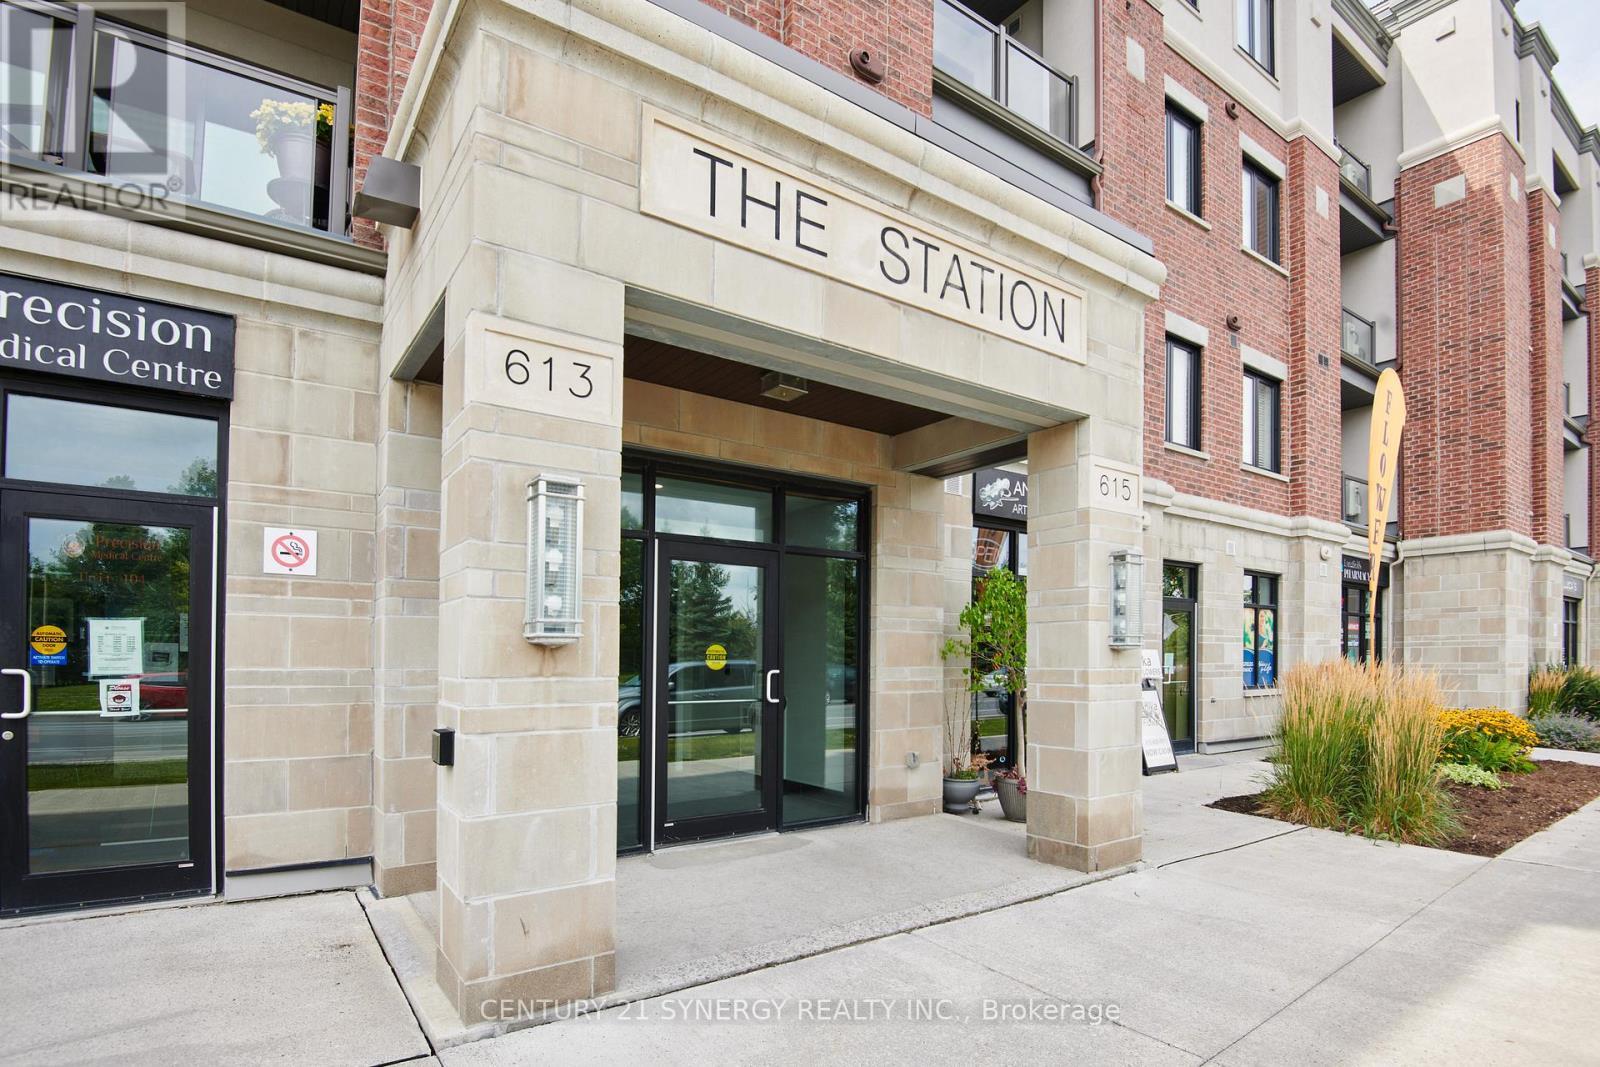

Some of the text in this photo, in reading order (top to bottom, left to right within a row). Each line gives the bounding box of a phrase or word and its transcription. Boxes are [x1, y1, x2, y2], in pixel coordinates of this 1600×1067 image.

[693, 147, 1065, 344] THE STATION
[103, 349, 222, 389] Centre
[505, 349, 593, 398] 613
[1099, 474, 1131, 501] 615
[1367, 389, 1394, 599] FLOWER
[91, 549, 129, 561] Medical
[96, 534, 161, 551] Precision
